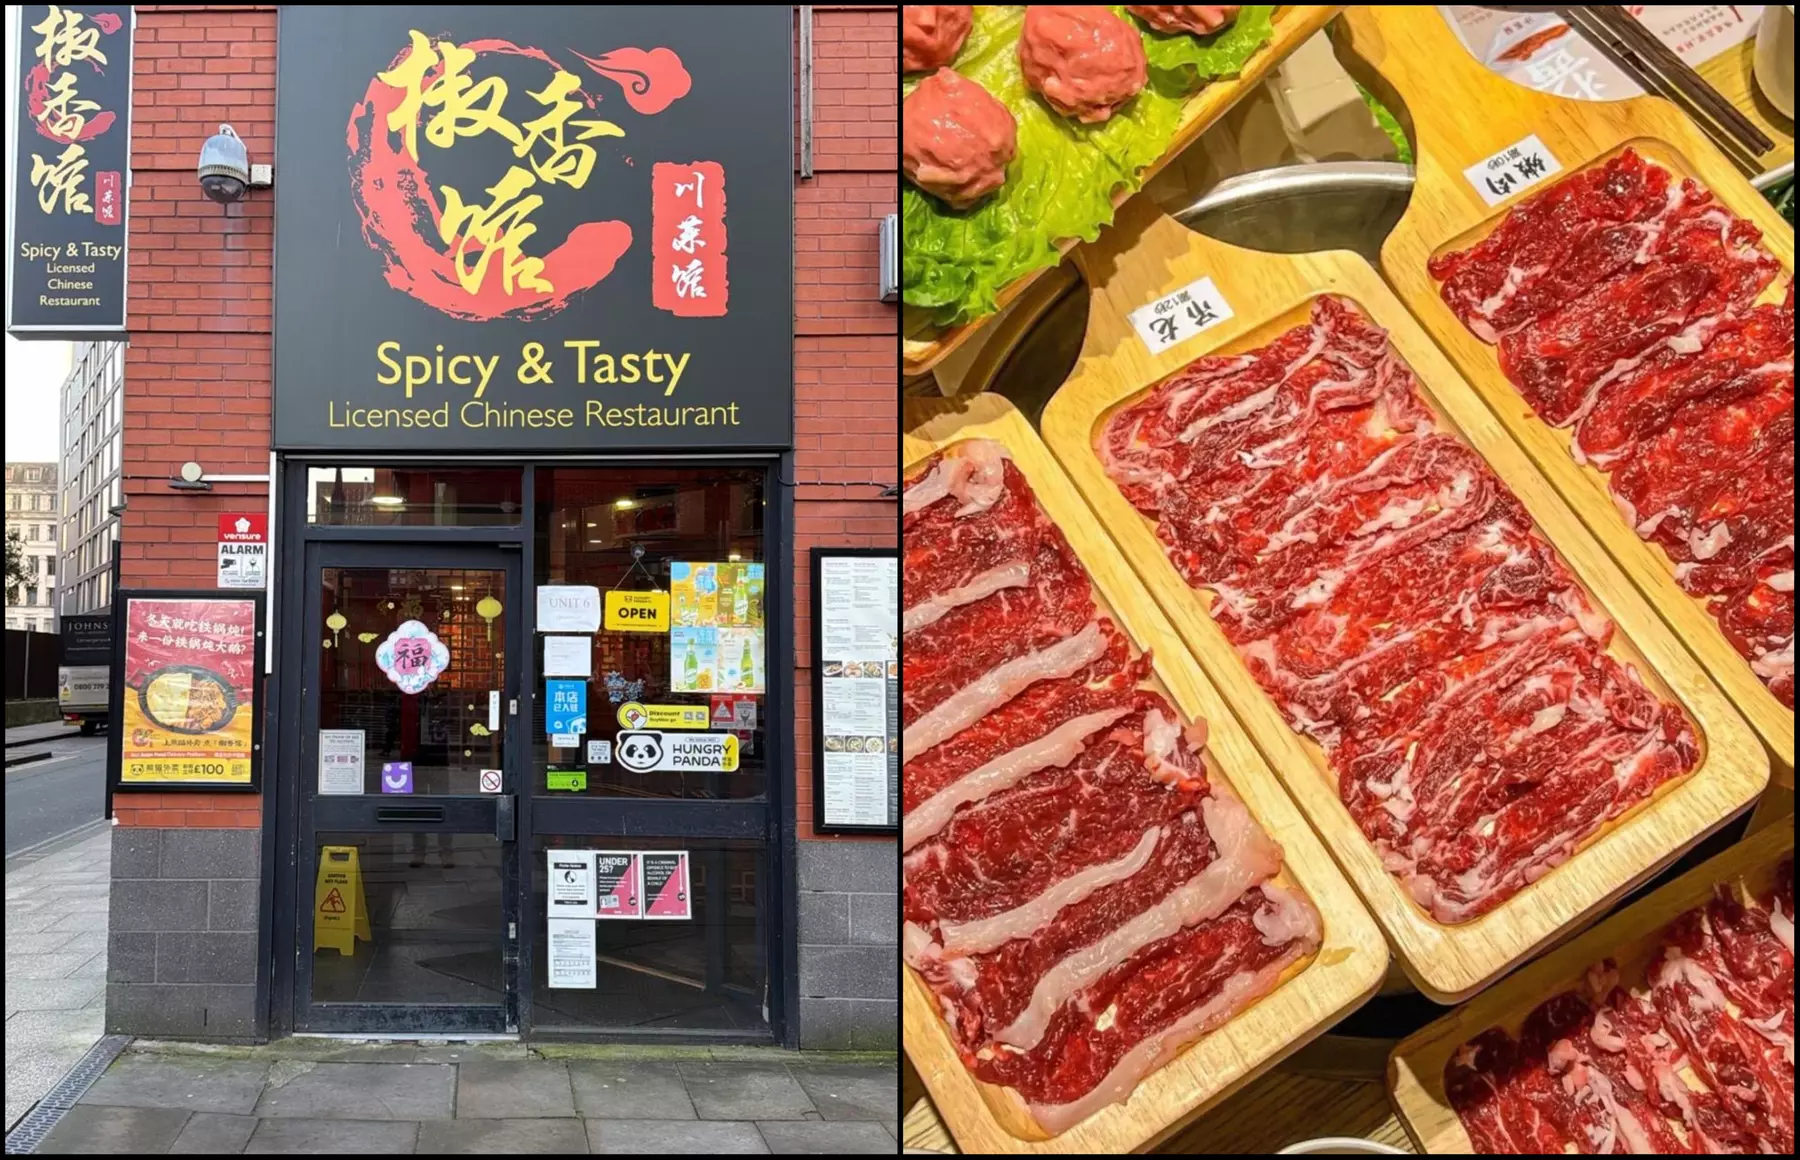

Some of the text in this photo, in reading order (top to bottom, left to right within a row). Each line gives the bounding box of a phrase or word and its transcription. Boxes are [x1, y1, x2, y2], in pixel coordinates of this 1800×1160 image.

[672, 172, 707, 299] 川菜馆
[20, 242, 122, 261] Spicy & Tasty
[46, 262, 95, 274] Licensed
[47, 278, 94, 290] Chinese
[39, 295, 101, 307] Restaurant
[1148, 297, 1220, 343] 吊龙
[376, 340, 691, 398] Spicy & Tasty
[329, 400, 741, 428] Licensed Chinese Restaurant
[223, 532, 262, 541] verisure
[220, 545, 264, 554] ALARM
[549, 598, 591, 609] UNIT 6
[618, 607, 657, 619] OPEN
[396, 643, 429, 670] 福
[672, 744, 732, 755] HUNGRY
[672, 756, 721, 767] PANDA
[194, 763, 225, 775] £100
[599, 857, 628, 866] UNDER
[599, 865, 614, 873] 25?
